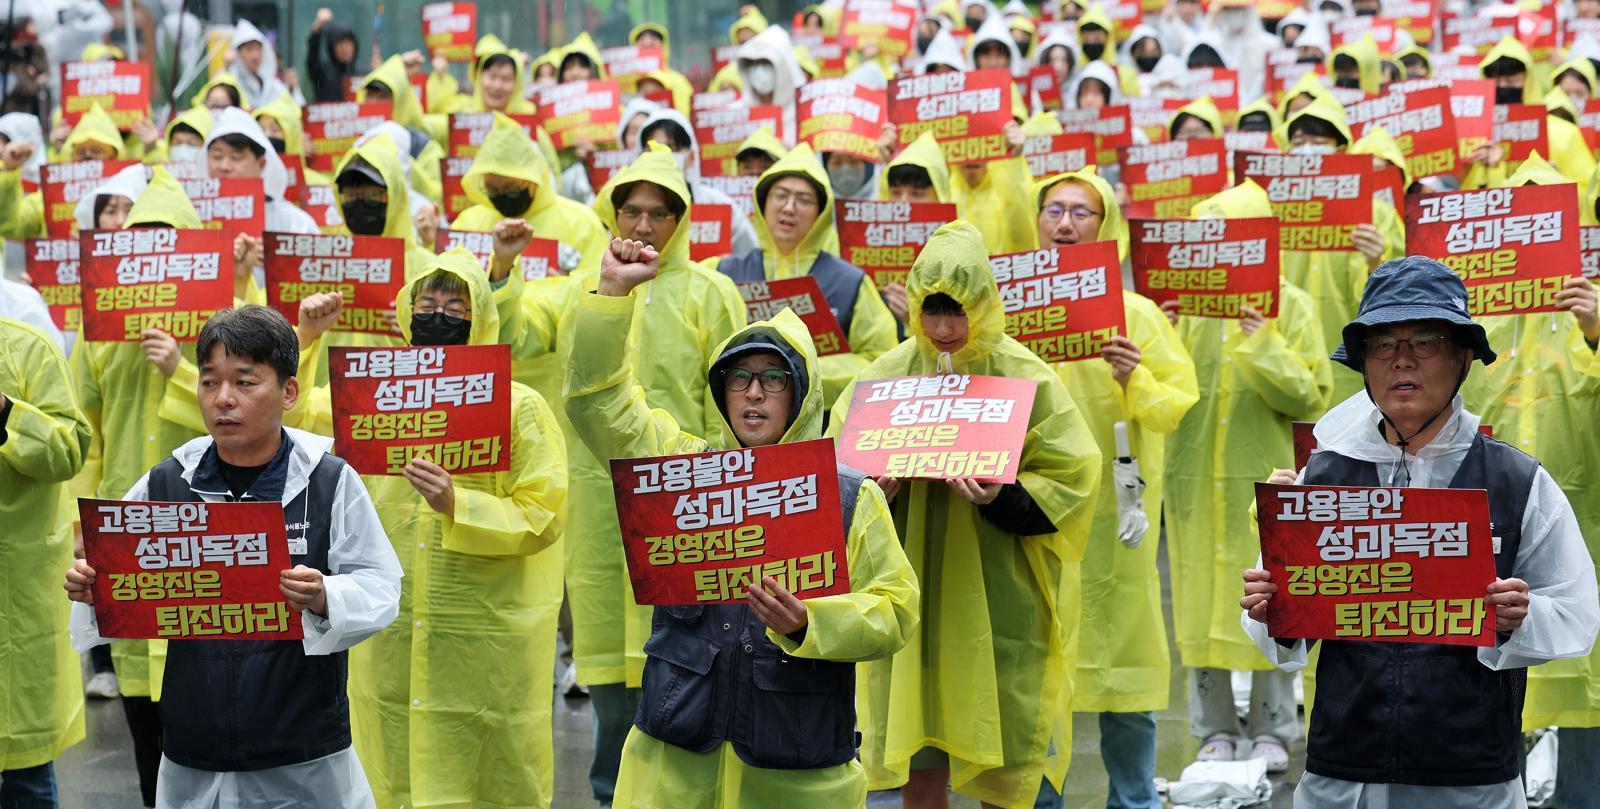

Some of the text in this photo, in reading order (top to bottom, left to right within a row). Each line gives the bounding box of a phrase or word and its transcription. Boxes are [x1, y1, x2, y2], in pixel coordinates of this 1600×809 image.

[896, 71, 967, 100] 고용불안
[917, 88, 1001, 121] 성과독점
[1026, 148, 1086, 176] 과독점
[1244, 154, 1323, 176] 고용불안
[1405, 148, 1456, 179] 하라
[184, 177, 220, 198] 불안
[1267, 174, 1361, 202] 성과독점
[192, 195, 254, 221] 과독점
[844, 201, 911, 222] 고용불안
[1271, 201, 1324, 222] 진은
[1417, 188, 1514, 225] 고용불안
[92, 228, 178, 256] 고용불안
[276, 234, 354, 257] 고용불안
[445, 231, 494, 255] 고용
[1142, 218, 1226, 243] 고용불안
[1445, 210, 1563, 254] 성과독점
[35, 239, 80, 262] 고용
[851, 247, 915, 267] 경영진은
[990, 248, 1060, 283] 용불안
[1167, 239, 1267, 269] 성과독점
[116, 252, 220, 284] 성과독점
[299, 258, 392, 284] 성과독점
[1147, 268, 1229, 291] 경영진은
[1438, 250, 1518, 282] 영진은
[39, 285, 81, 306] 경영
[95, 282, 178, 312] 경영진은
[740, 281, 771, 301] 불안
[999, 267, 1107, 313] 성과독점
[1177, 291, 1273, 318] 퇴진하라
[334, 308, 396, 332] 진하
[746, 293, 817, 323] 과독점
[1004, 305, 1068, 337] 영진은
[344, 347, 446, 378] 고용불안
[374, 372, 495, 411] 성과독점
[865, 374, 970, 403] 고용불안
[350, 409, 449, 441] 경영진은
[889, 399, 1015, 426] 성과독점
[855, 424, 960, 451] 경영진은
[386, 435, 503, 474] 퇴진하라
[884, 451, 1011, 479] 퇴진하라
[633, 449, 755, 494] 고용불안
[672, 474, 817, 531] 성과독점
[1276, 488, 1404, 522] 고용불안
[98, 503, 209, 534] 고용불안
[134, 532, 269, 570] 성과독점
[645, 524, 765, 566] 경영진은
[1316, 521, 1469, 562] 성과독점
[109, 570, 222, 601] 경영진은
[694, 550, 838, 602] 퇴진하라
[1285, 562, 1413, 596] 경영진은
[155, 601, 290, 637] 퇴진하라
[1335, 597, 1487, 638] 퇴진하라
